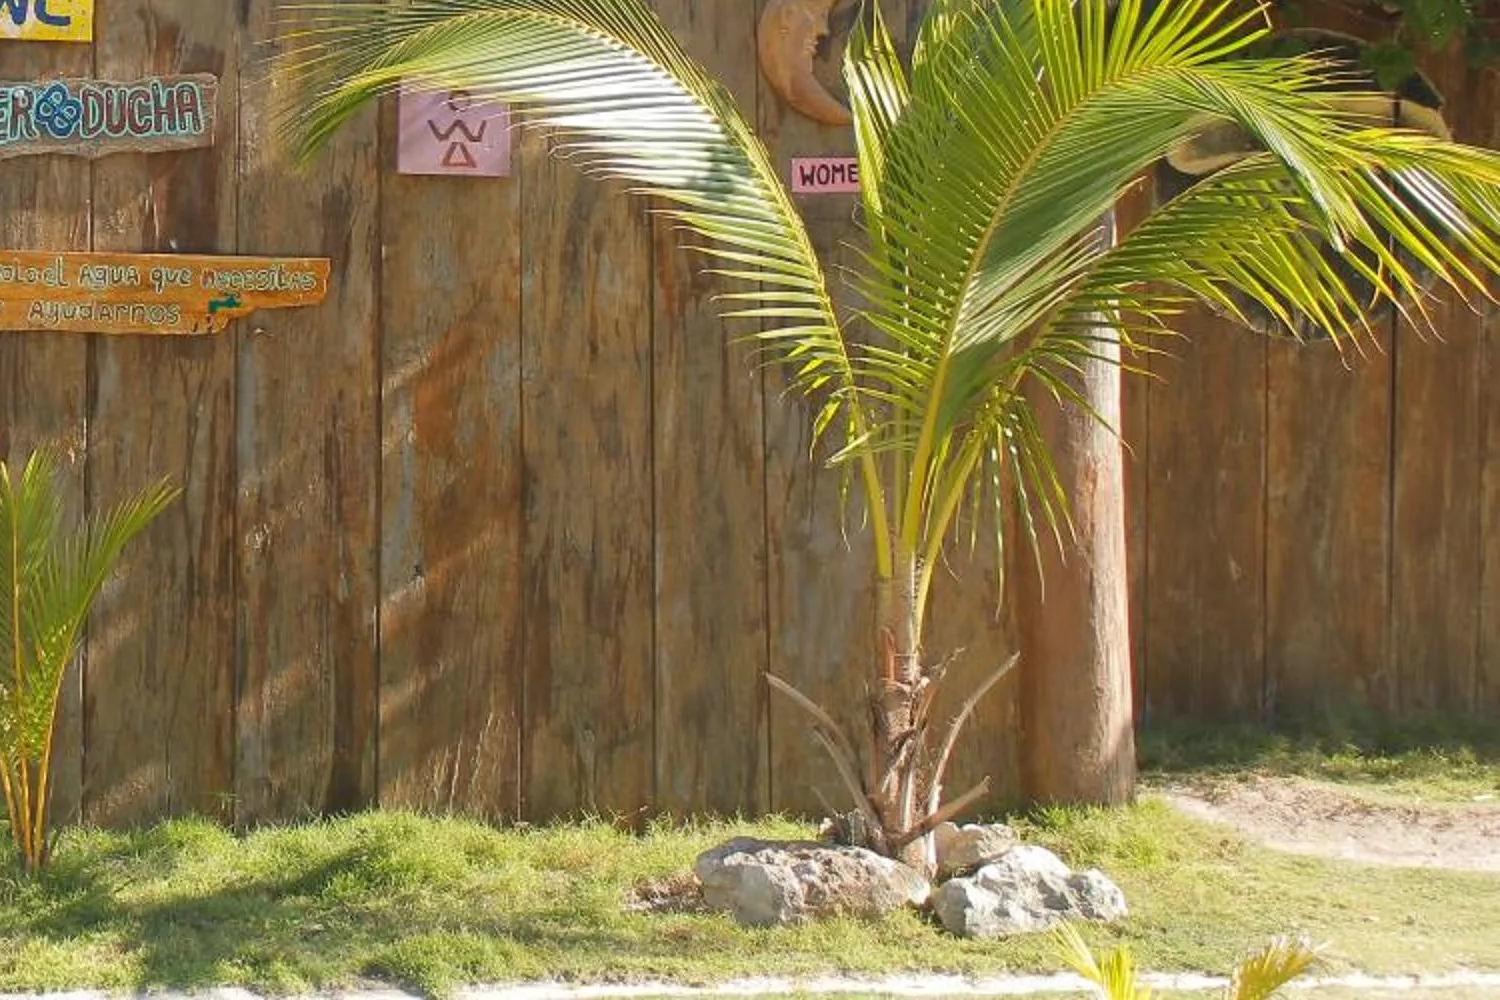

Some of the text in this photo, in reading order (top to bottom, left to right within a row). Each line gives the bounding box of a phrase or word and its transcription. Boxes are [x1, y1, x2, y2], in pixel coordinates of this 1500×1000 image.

[80, 79, 203, 138] DUCHA
[799, 163, 859, 187] WOME
[150, 265, 192, 294] que
